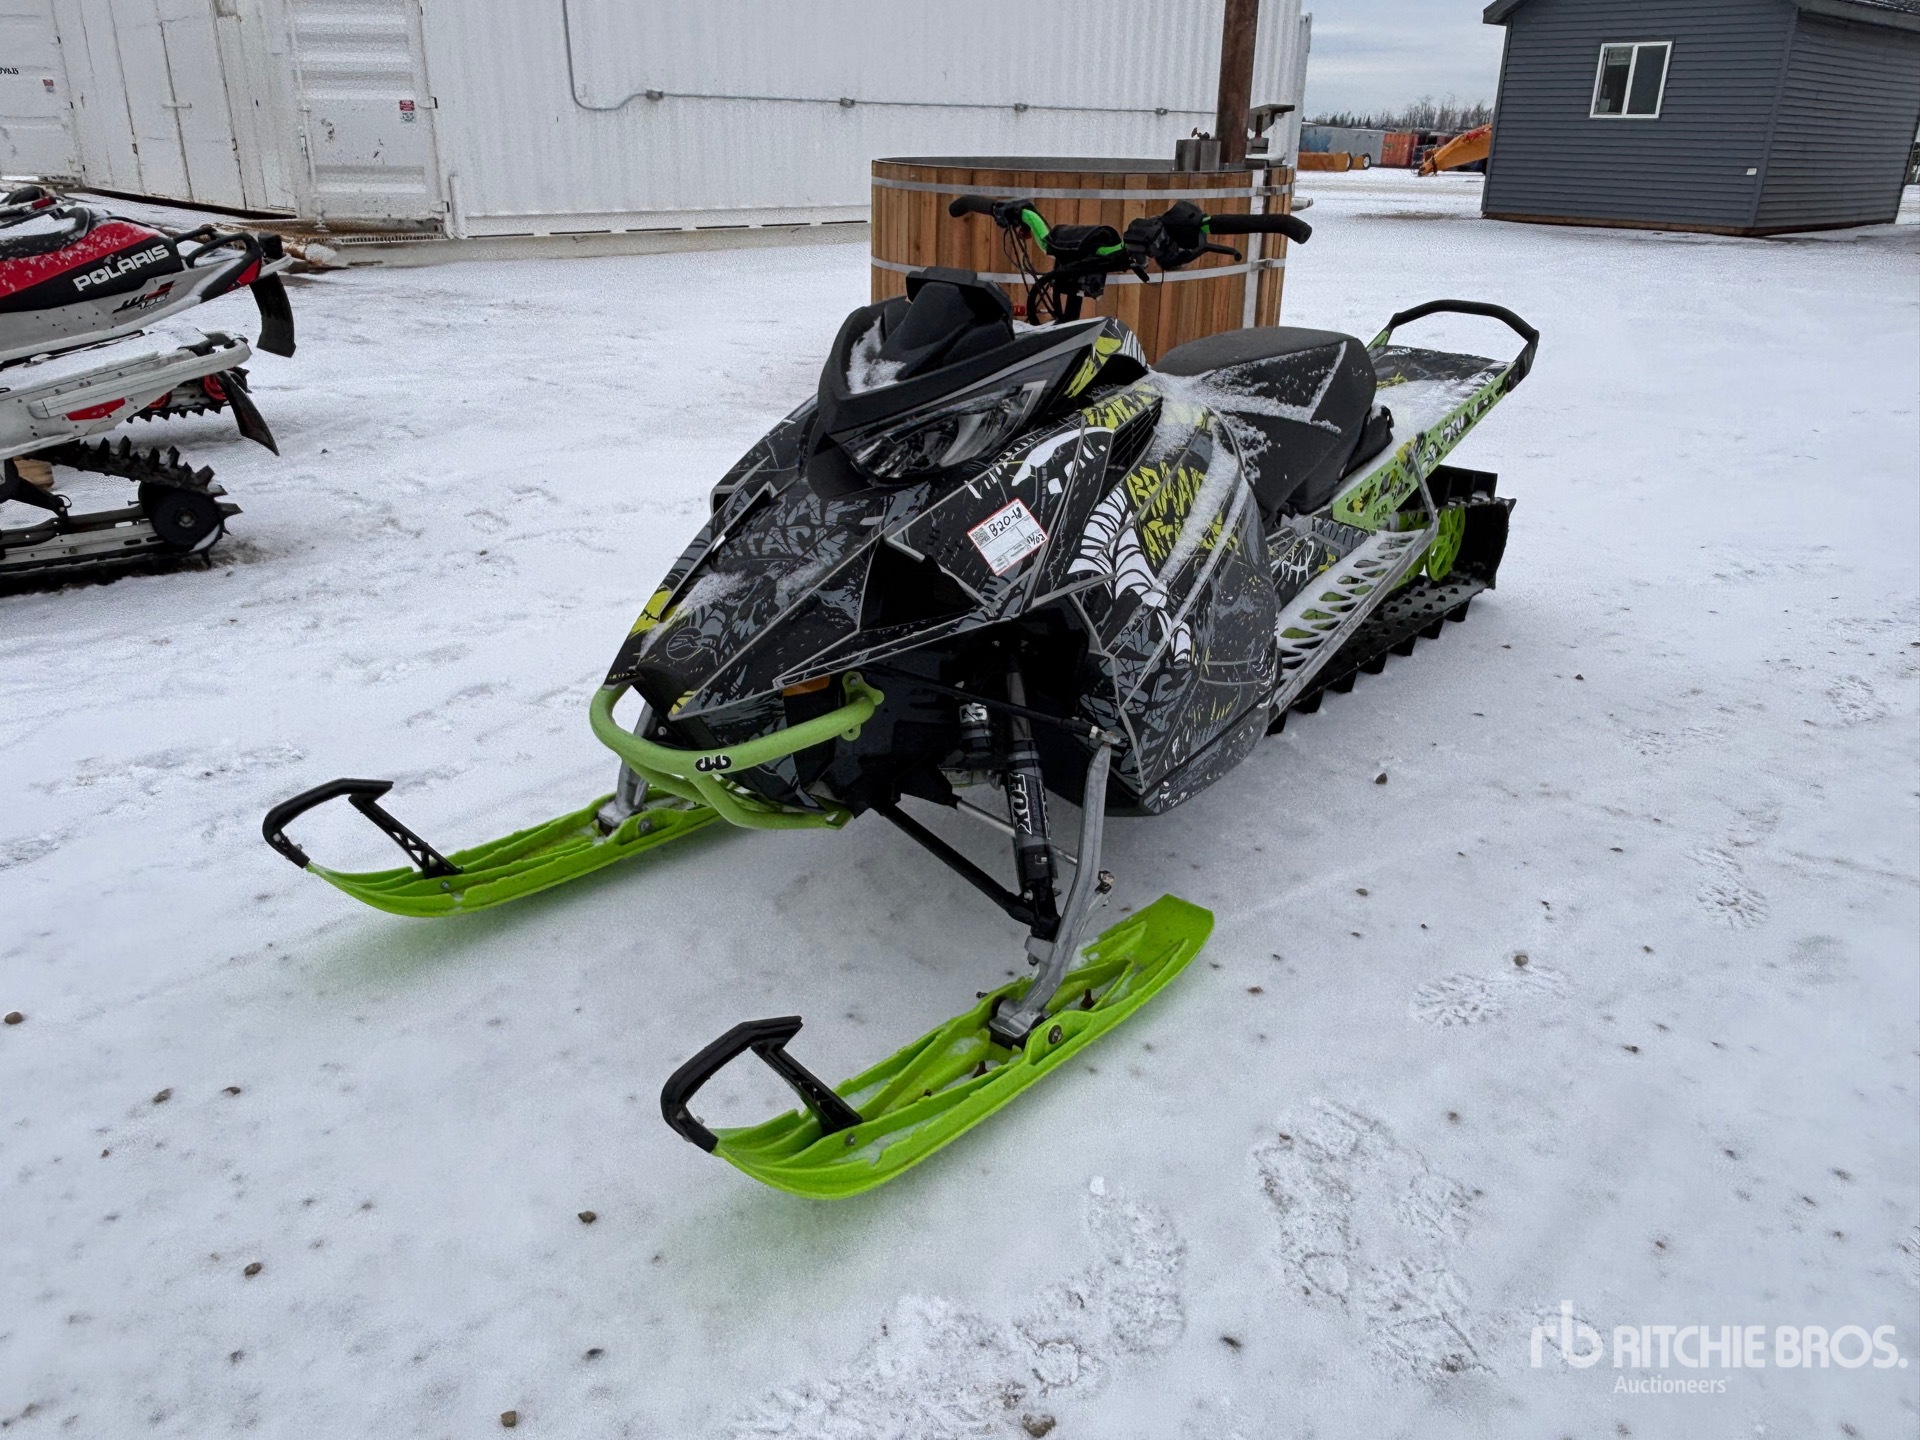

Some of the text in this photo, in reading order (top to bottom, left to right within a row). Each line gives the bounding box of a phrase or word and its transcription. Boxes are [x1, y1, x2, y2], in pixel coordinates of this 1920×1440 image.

[73, 244, 170, 292] POLARIS
[988, 506, 1023, 537] B20-18
[1009, 772, 1033, 835] FOX
